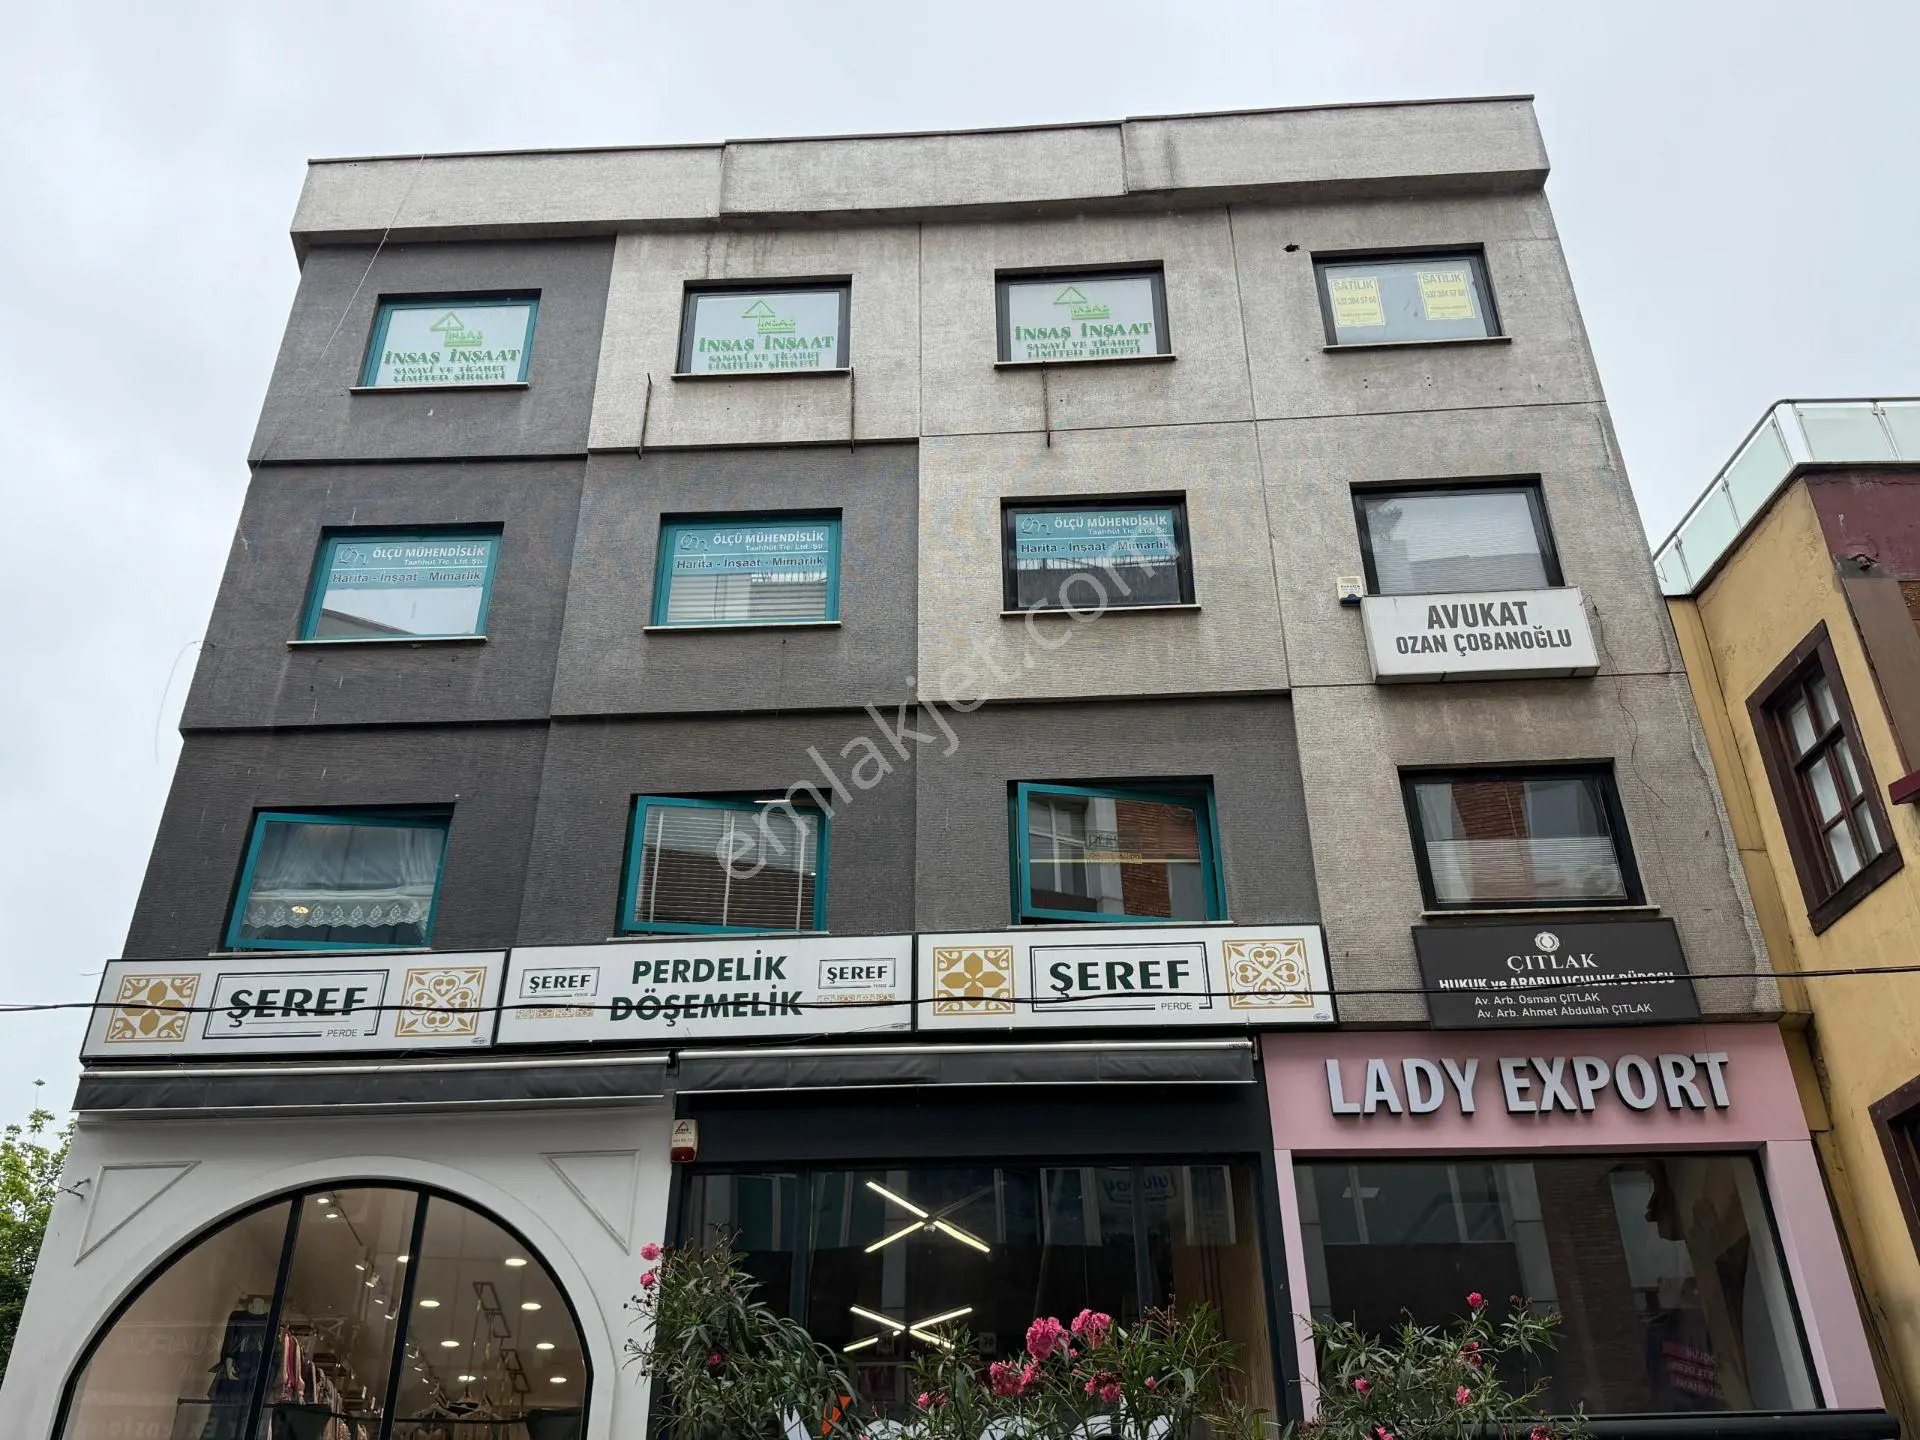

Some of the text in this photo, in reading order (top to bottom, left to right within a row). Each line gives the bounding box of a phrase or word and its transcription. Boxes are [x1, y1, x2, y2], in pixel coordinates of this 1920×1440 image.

[1334, 279, 1374, 291] SATILIK
[1423, 272, 1462, 284] SATILIK
[1054, 517, 1083, 530] ÖLÇÜ
[1087, 514, 1167, 527] MÜHENDİSLİK
[713, 533, 742, 546] ÖLÇÜ
[745, 530, 824, 543] MÜHENDİSLİK
[373, 546, 402, 560] ÖLÇÜ
[405, 545, 486, 557] MÜHENDİSLİK
[1021, 543, 1057, 553] Harita
[1069, 542, 1106, 553] İnşaat
[677, 559, 713, 569] Harita
[724, 558, 761, 568] İnşaat
[333, 572, 369, 583] Harita
[1428, 601, 1529, 630] AVUKAT
[1395, 625, 1573, 657] OZAN ÇOBANOĞLU
[631, 949, 789, 985] PERDELİK
[1506, 953, 1599, 974] ÇITLAK
[826, 965, 888, 984] ŞEREF
[1049, 959, 1190, 999] ŞEREF
[529, 974, 592, 993] ŞEREF
[1439, 978, 1487, 991] HUKUK
[1491, 980, 1507, 991] ve
[226, 986, 368, 1028] ŞEREF
[609, 984, 804, 1027] DÖŞEMELİK
[1160, 1001, 1193, 1011] PERDE
[1475, 992, 1602, 1006] Av. Arb. Osman ÇITLAK
[1477, 1003, 1653, 1019] Av. Arb. Ahmet Abdullah ÇITLAK
[326, 1027, 359, 1038] PERDE
[1324, 1052, 1729, 1117] LADY EXPORT
